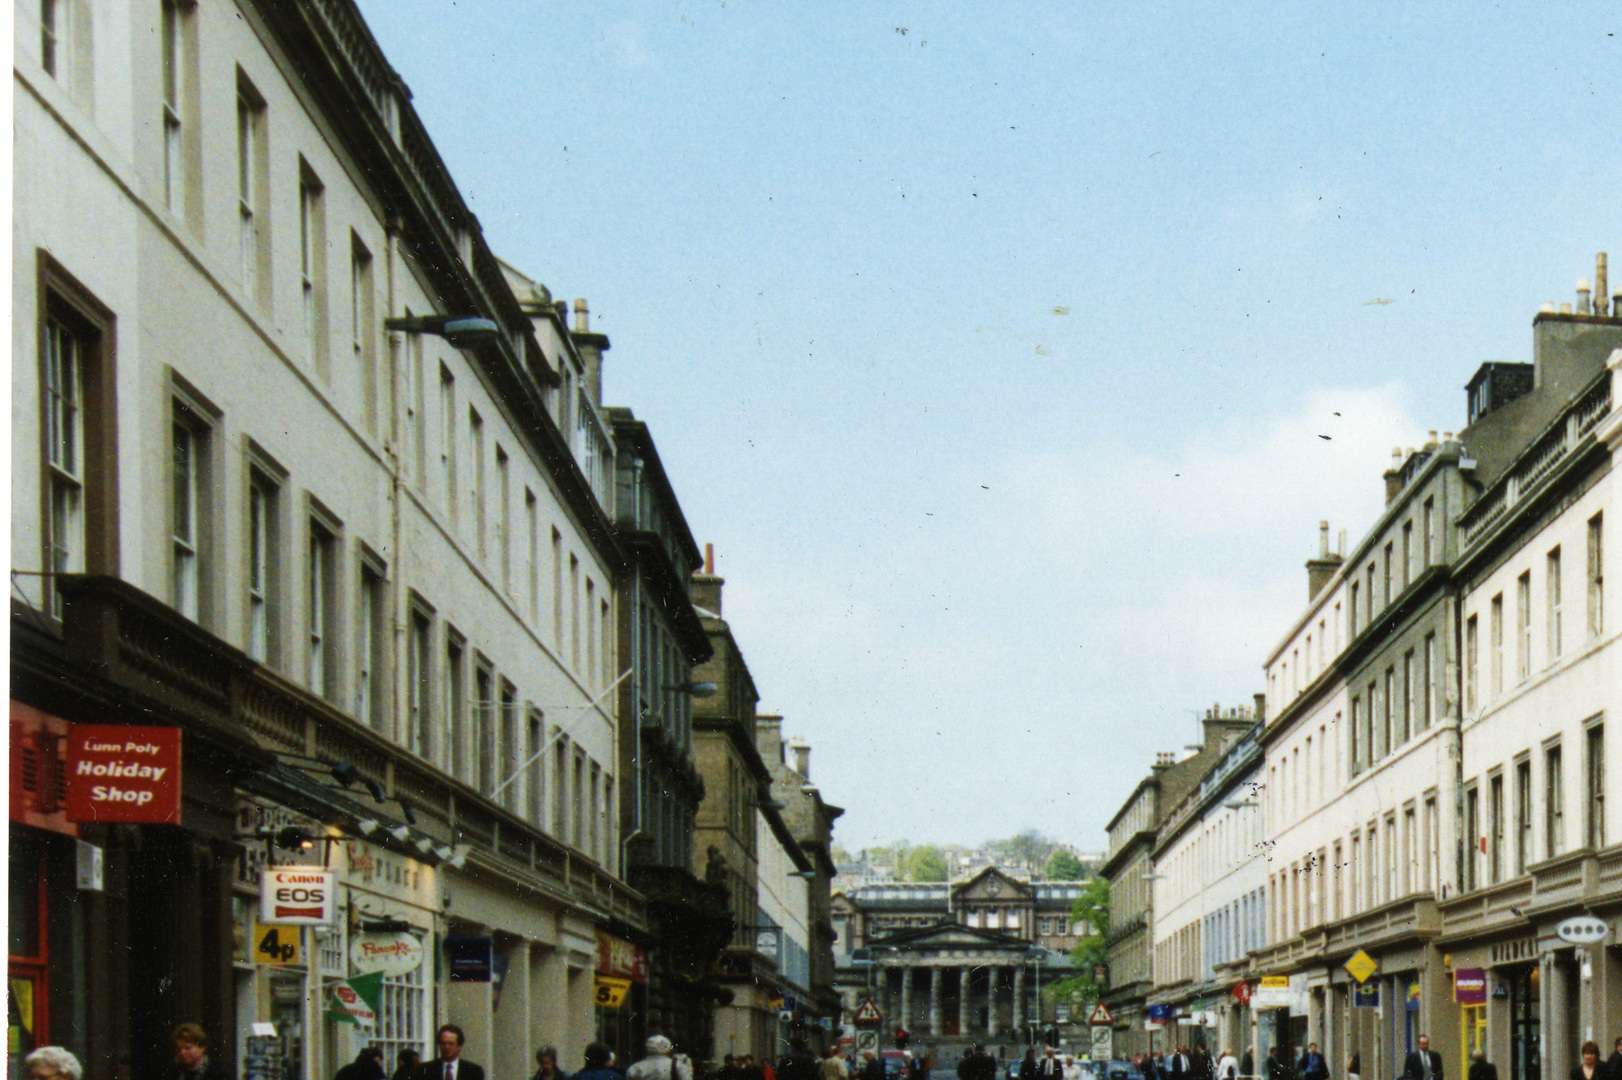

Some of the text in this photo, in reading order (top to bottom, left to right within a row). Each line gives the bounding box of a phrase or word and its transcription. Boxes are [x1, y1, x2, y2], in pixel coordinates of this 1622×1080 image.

[83, 740, 160, 755] Lunn Poly
[76, 760, 167, 782] Holiday
[91, 785, 154, 806] Shop
[276, 873, 325, 885] Canon
[276, 887, 325, 904] EOS
[259, 928, 295, 962] 4p
